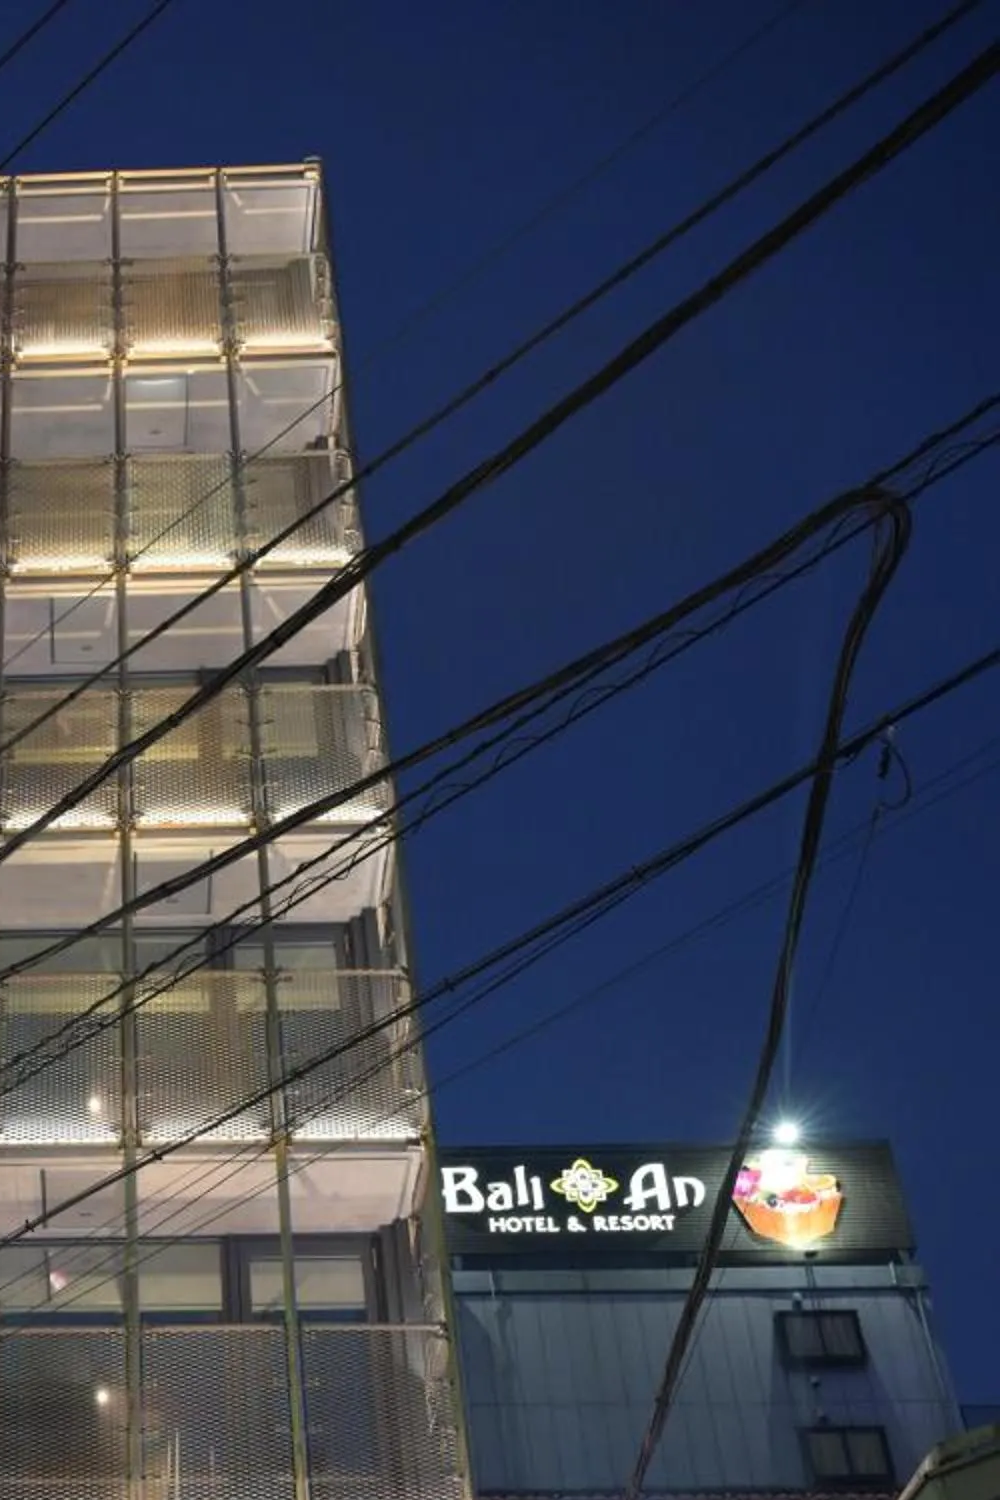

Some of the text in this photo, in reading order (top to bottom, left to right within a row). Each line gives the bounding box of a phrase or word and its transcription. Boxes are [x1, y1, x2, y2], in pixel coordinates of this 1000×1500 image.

[441, 1163, 705, 1214] Bali An
[488, 1214, 676, 1233] HOTEL & RESORT
